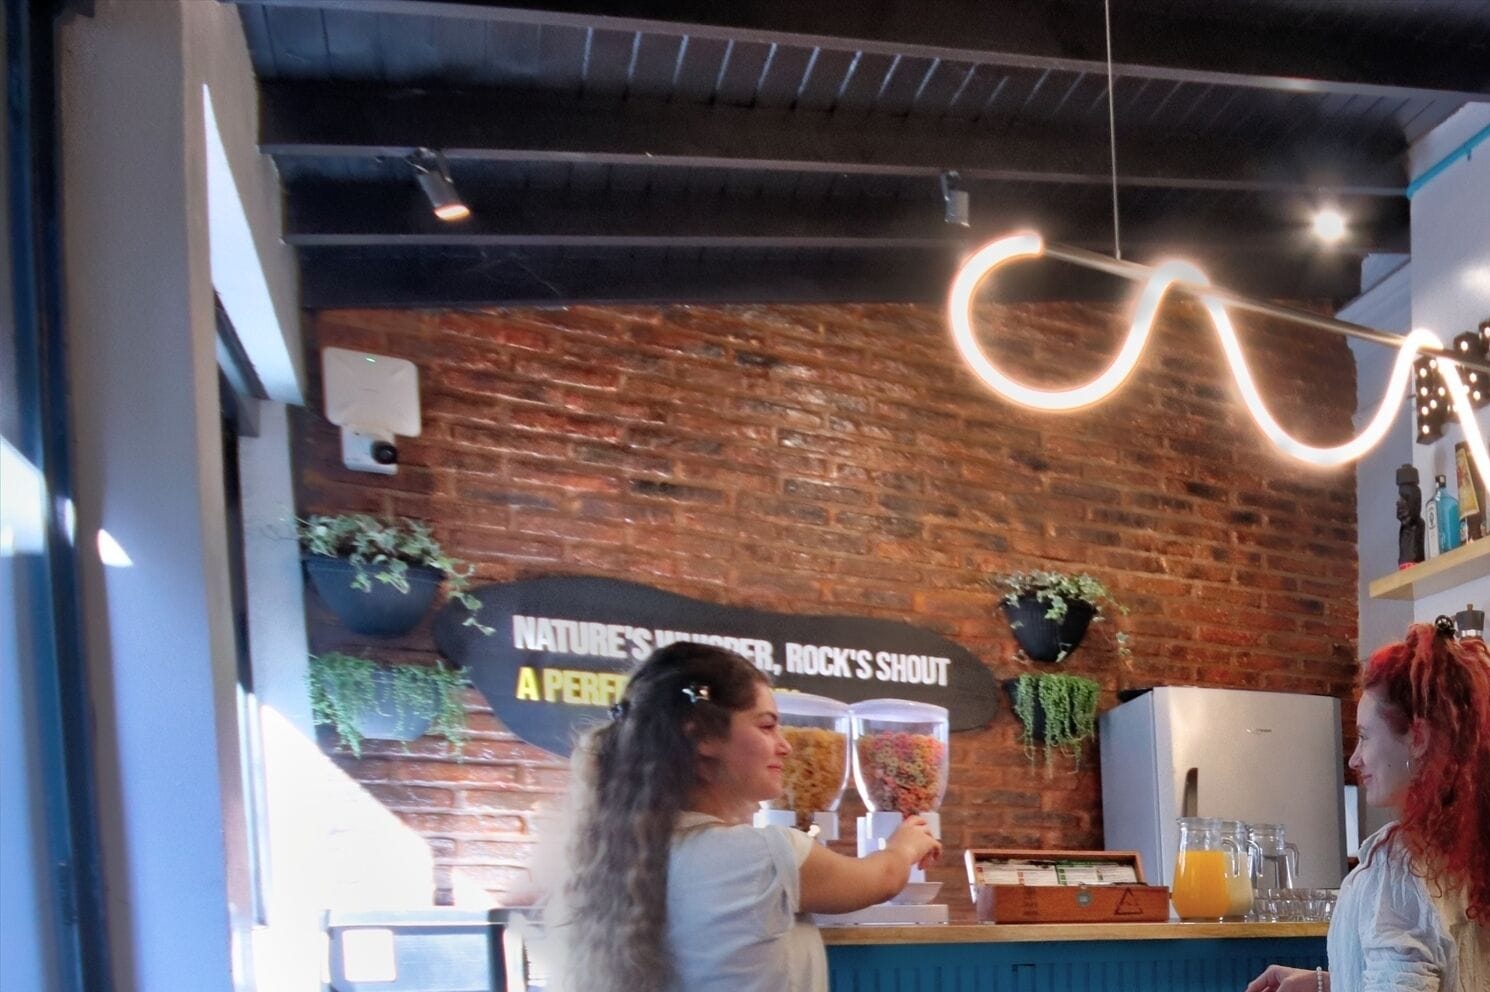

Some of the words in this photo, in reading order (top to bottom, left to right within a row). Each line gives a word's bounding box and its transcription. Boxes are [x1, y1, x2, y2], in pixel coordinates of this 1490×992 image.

[512, 614, 652, 661] NATURE'S
[785, 642, 873, 680] ROCK'S
[875, 651, 952, 687] SHOUT
[516, 666, 541, 701] A
